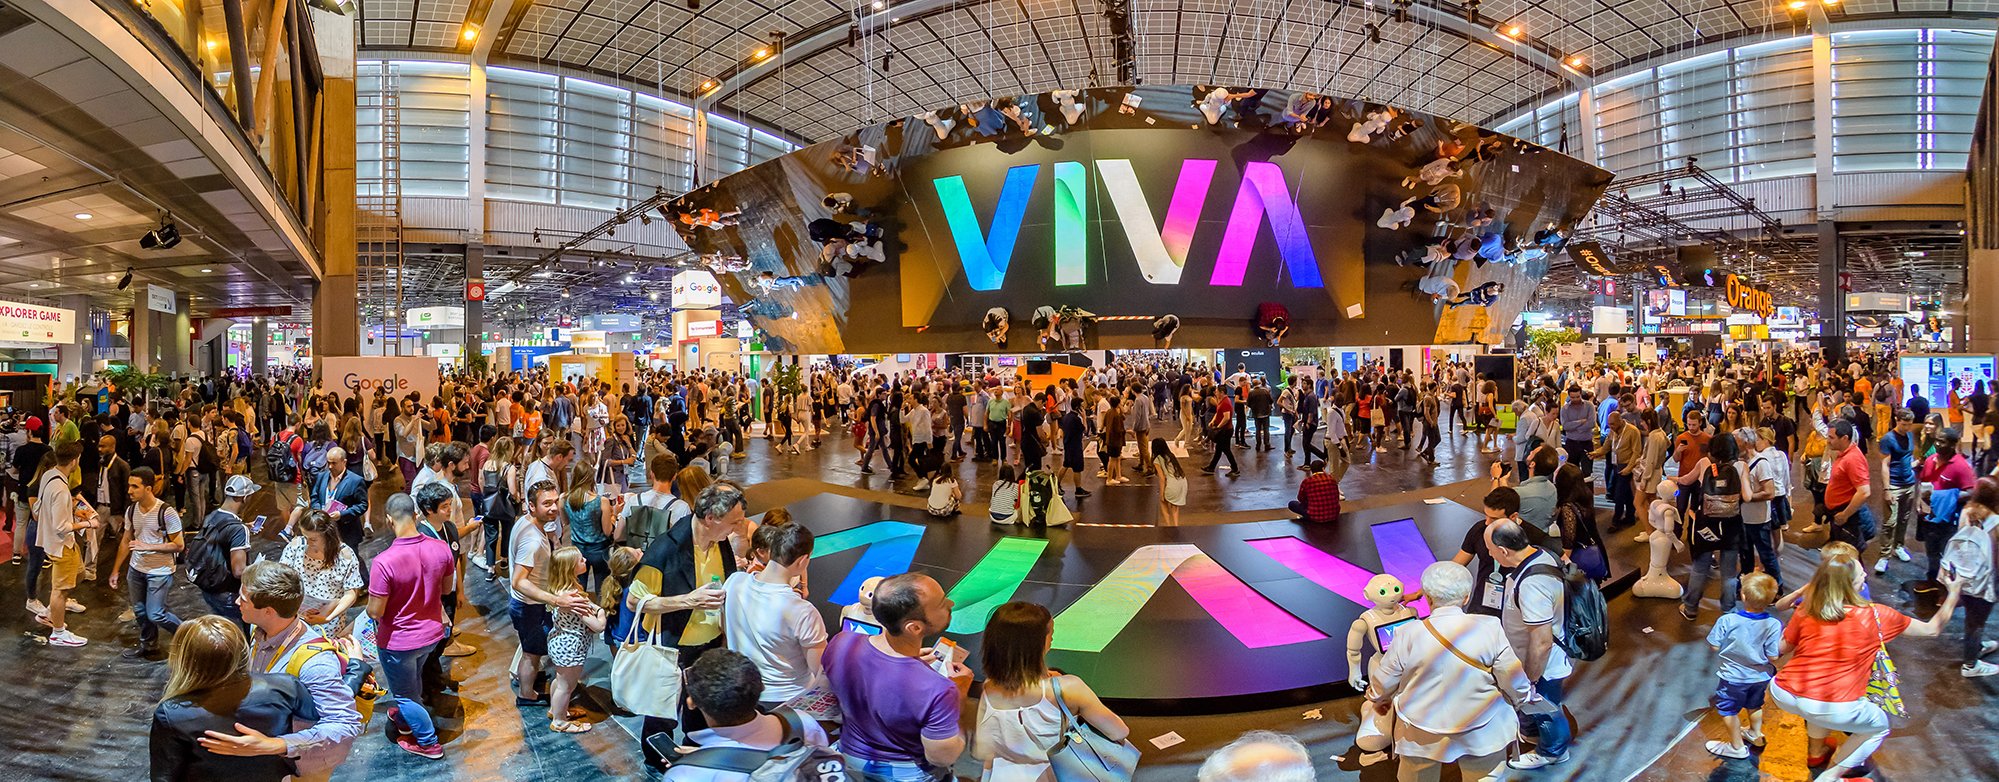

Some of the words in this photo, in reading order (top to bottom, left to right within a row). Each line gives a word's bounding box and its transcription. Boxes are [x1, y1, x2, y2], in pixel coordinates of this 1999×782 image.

[933, 159, 1324, 292] VIVA
[690, 282, 718, 294] Google
[1726, 273, 1773, 319] Orange
[40, 310, 61, 322] GAME
[344, 373, 409, 395] Google
